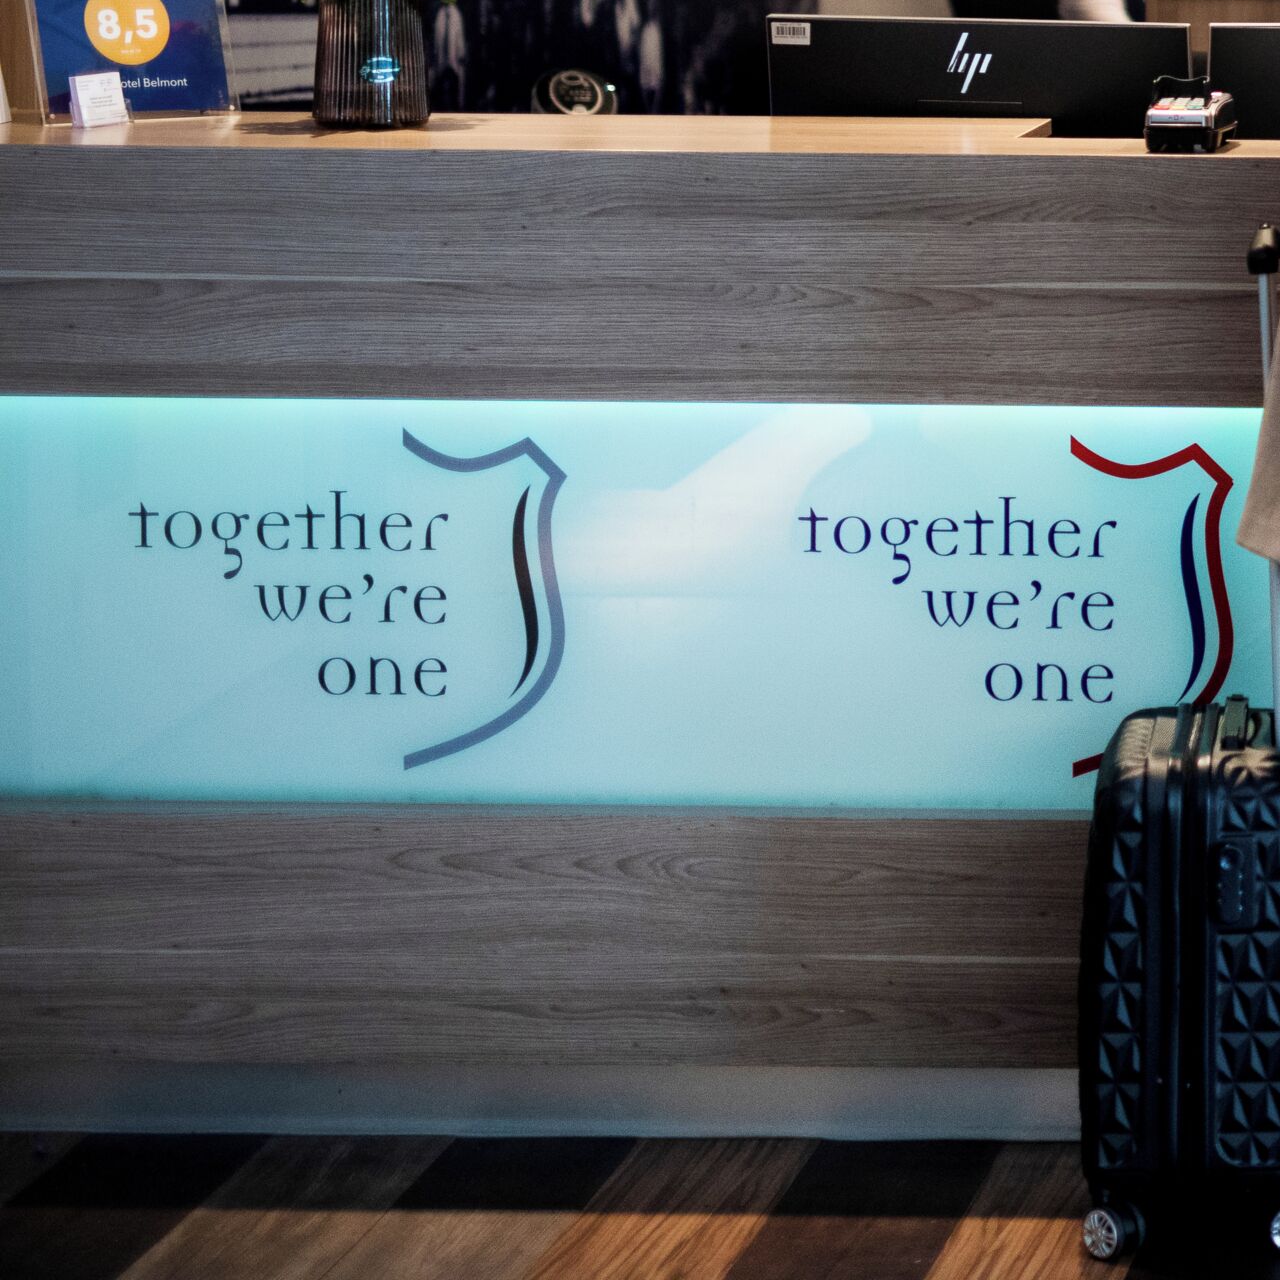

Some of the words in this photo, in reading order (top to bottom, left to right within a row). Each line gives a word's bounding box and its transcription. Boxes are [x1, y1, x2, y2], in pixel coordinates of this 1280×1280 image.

[97, 8, 158, 45] 8,5
[121, 77, 141, 89] otel
[143, 76, 188, 89] Belmont
[947, 32, 993, 94] hp
[128, 490, 448, 580] together
[798, 496, 1117, 585] together
[317, 656, 448, 697] one
[984, 662, 1115, 704] one
